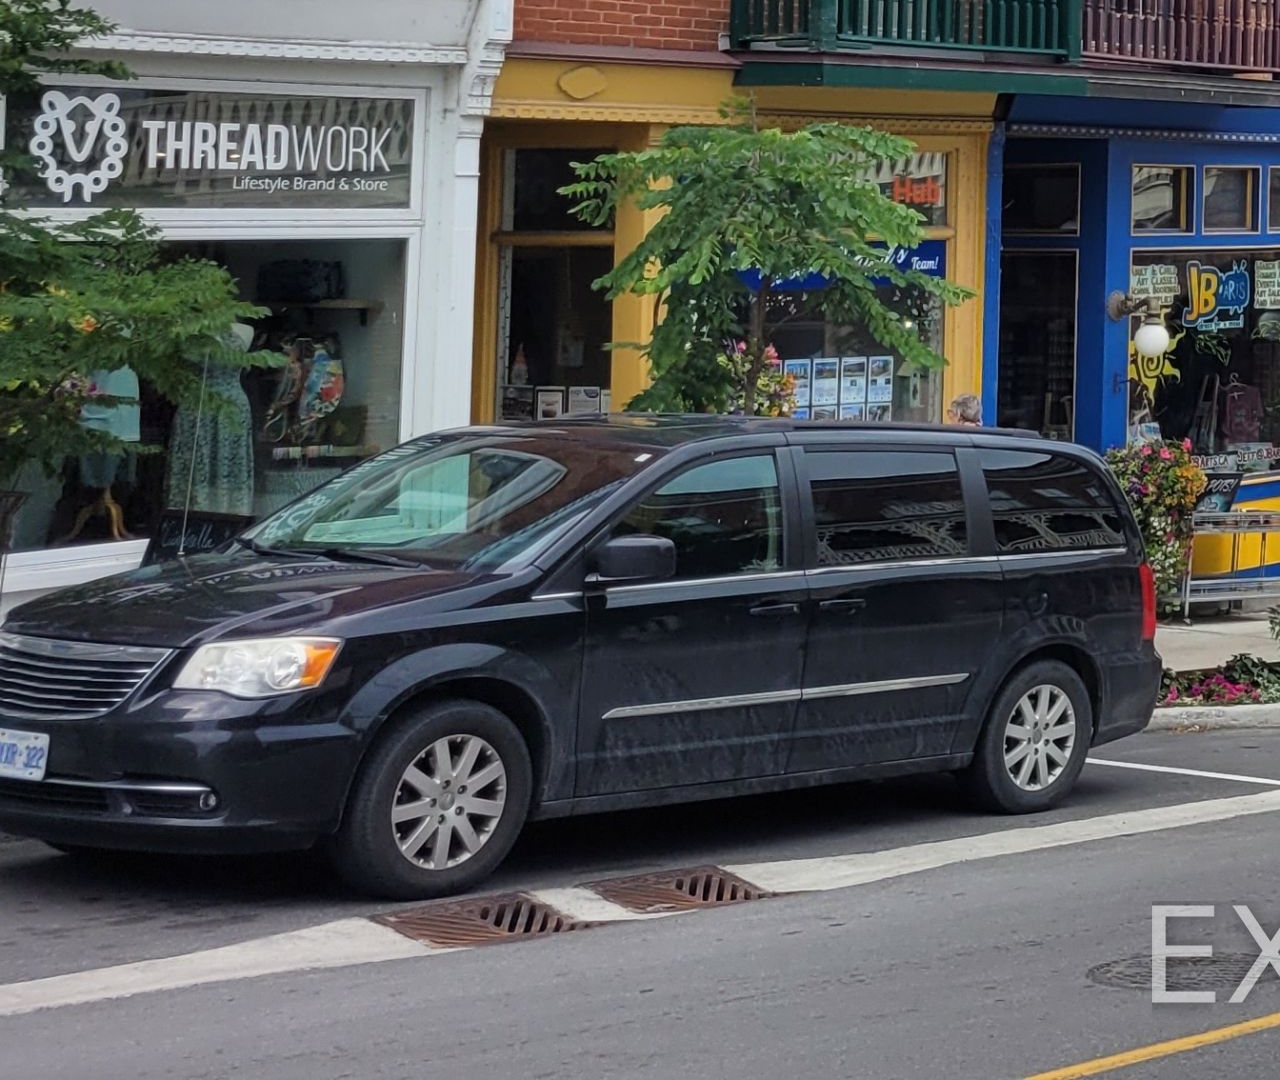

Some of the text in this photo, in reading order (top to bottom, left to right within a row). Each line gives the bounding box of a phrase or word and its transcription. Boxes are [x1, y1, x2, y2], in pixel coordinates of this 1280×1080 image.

[142, 120, 392, 172] THREADWORK
[232, 175, 388, 194] Lifestyle Brand & Store
[893, 175, 942, 205] Hub
[911, 256, 939, 270] Team!
